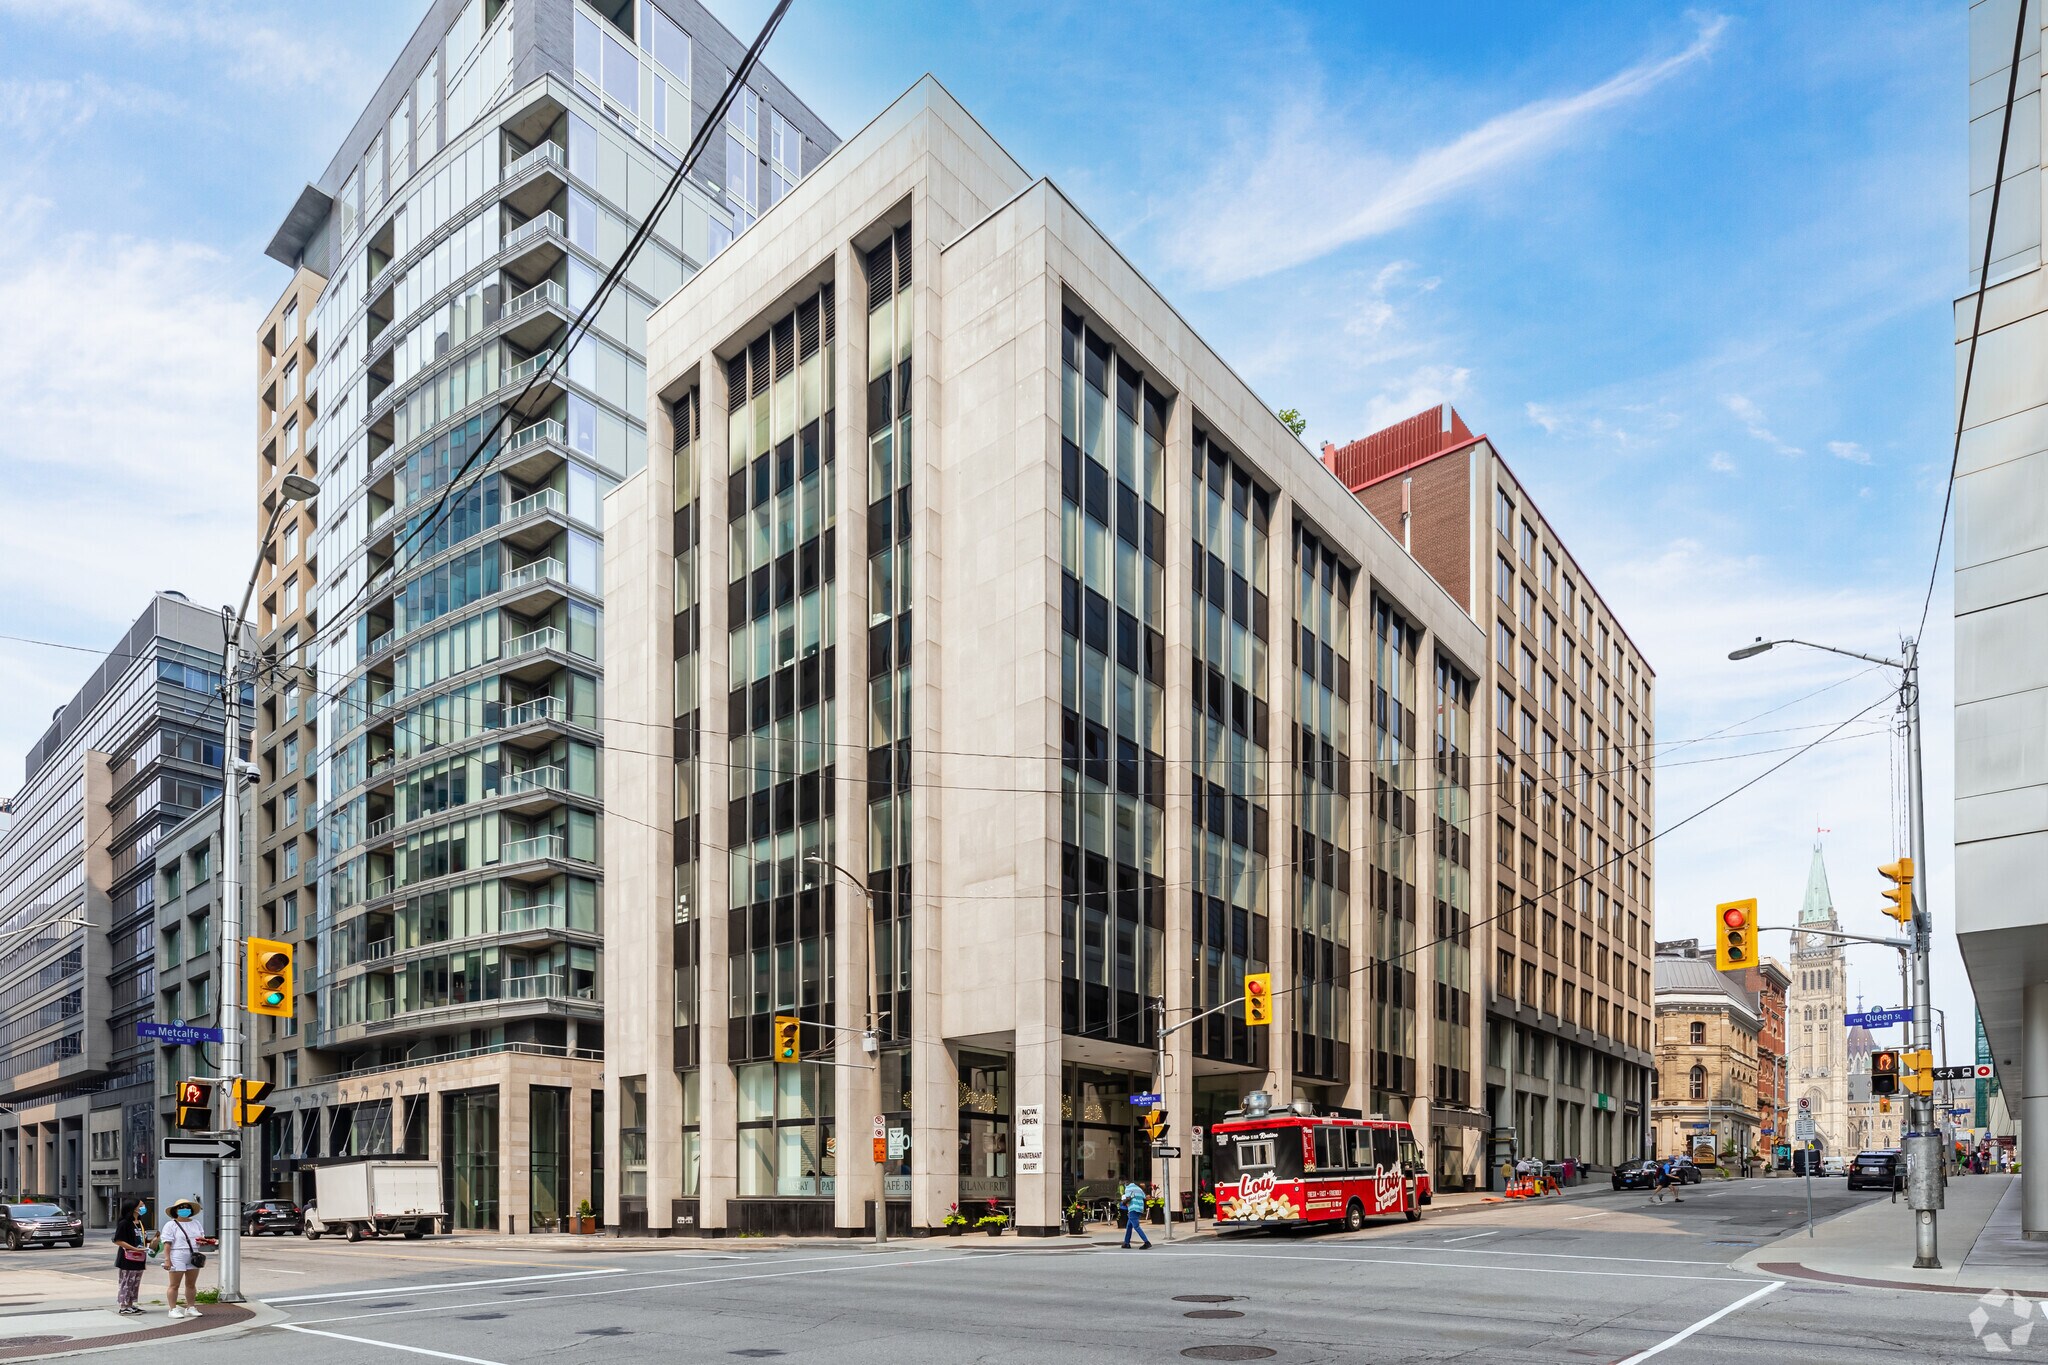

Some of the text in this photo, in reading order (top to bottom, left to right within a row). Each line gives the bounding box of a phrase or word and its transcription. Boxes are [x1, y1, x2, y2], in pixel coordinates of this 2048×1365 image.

[1865, 1013, 1892, 1023] Queen
[158, 1026, 199, 1039] Metcalfe
[784, 1181, 809, 1191] AKERY
[885, 1179, 901, 1191] AFÉ
[1241, 1175, 1274, 1196] Lou
[1376, 1166, 1401, 1197] Lou
